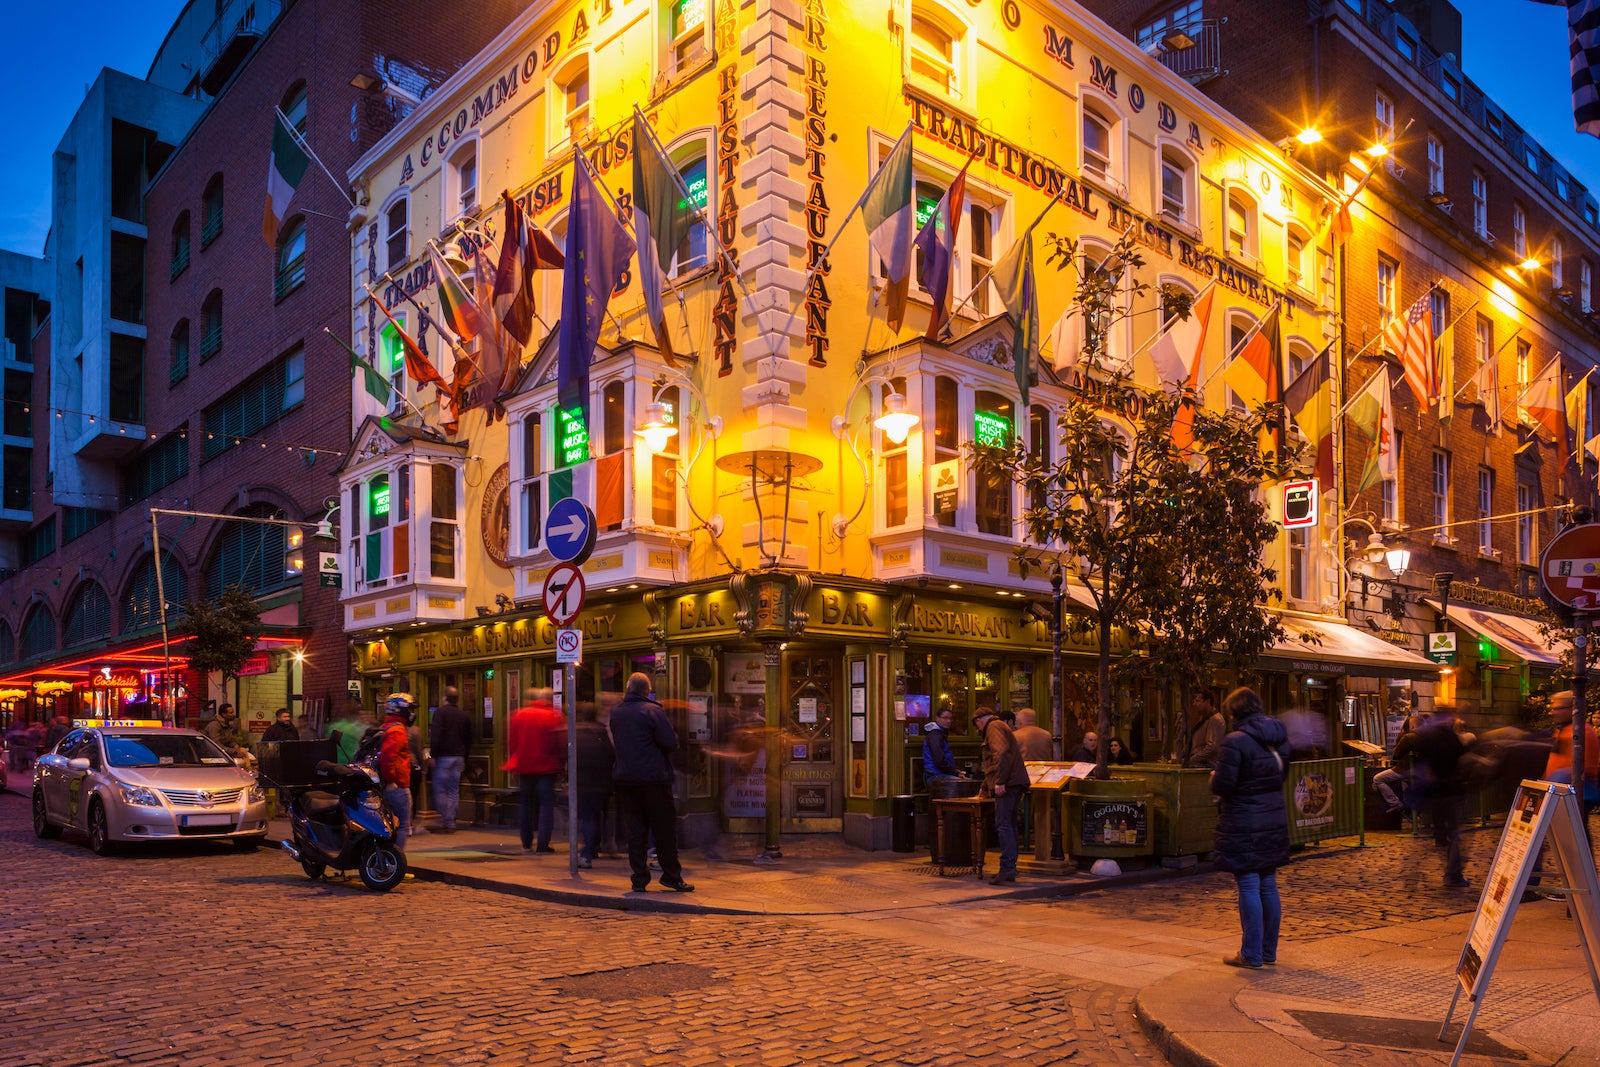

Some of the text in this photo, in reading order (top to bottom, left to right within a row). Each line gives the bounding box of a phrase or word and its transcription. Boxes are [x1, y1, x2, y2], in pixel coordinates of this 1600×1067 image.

[806, 54, 833, 368] RESTAURANT
[905, 96, 1295, 323] TRADITIONAL IRISH RESTAURANT
[712, 62, 740, 378] RESTAURANT
[979, 422, 1002, 438] IRISH
[563, 431, 588, 449] MUSIC
[566, 447, 582, 463] BAR
[94, 674, 139, 688] Cocktails
[1094, 804, 1139, 819] GOGARTY'S
